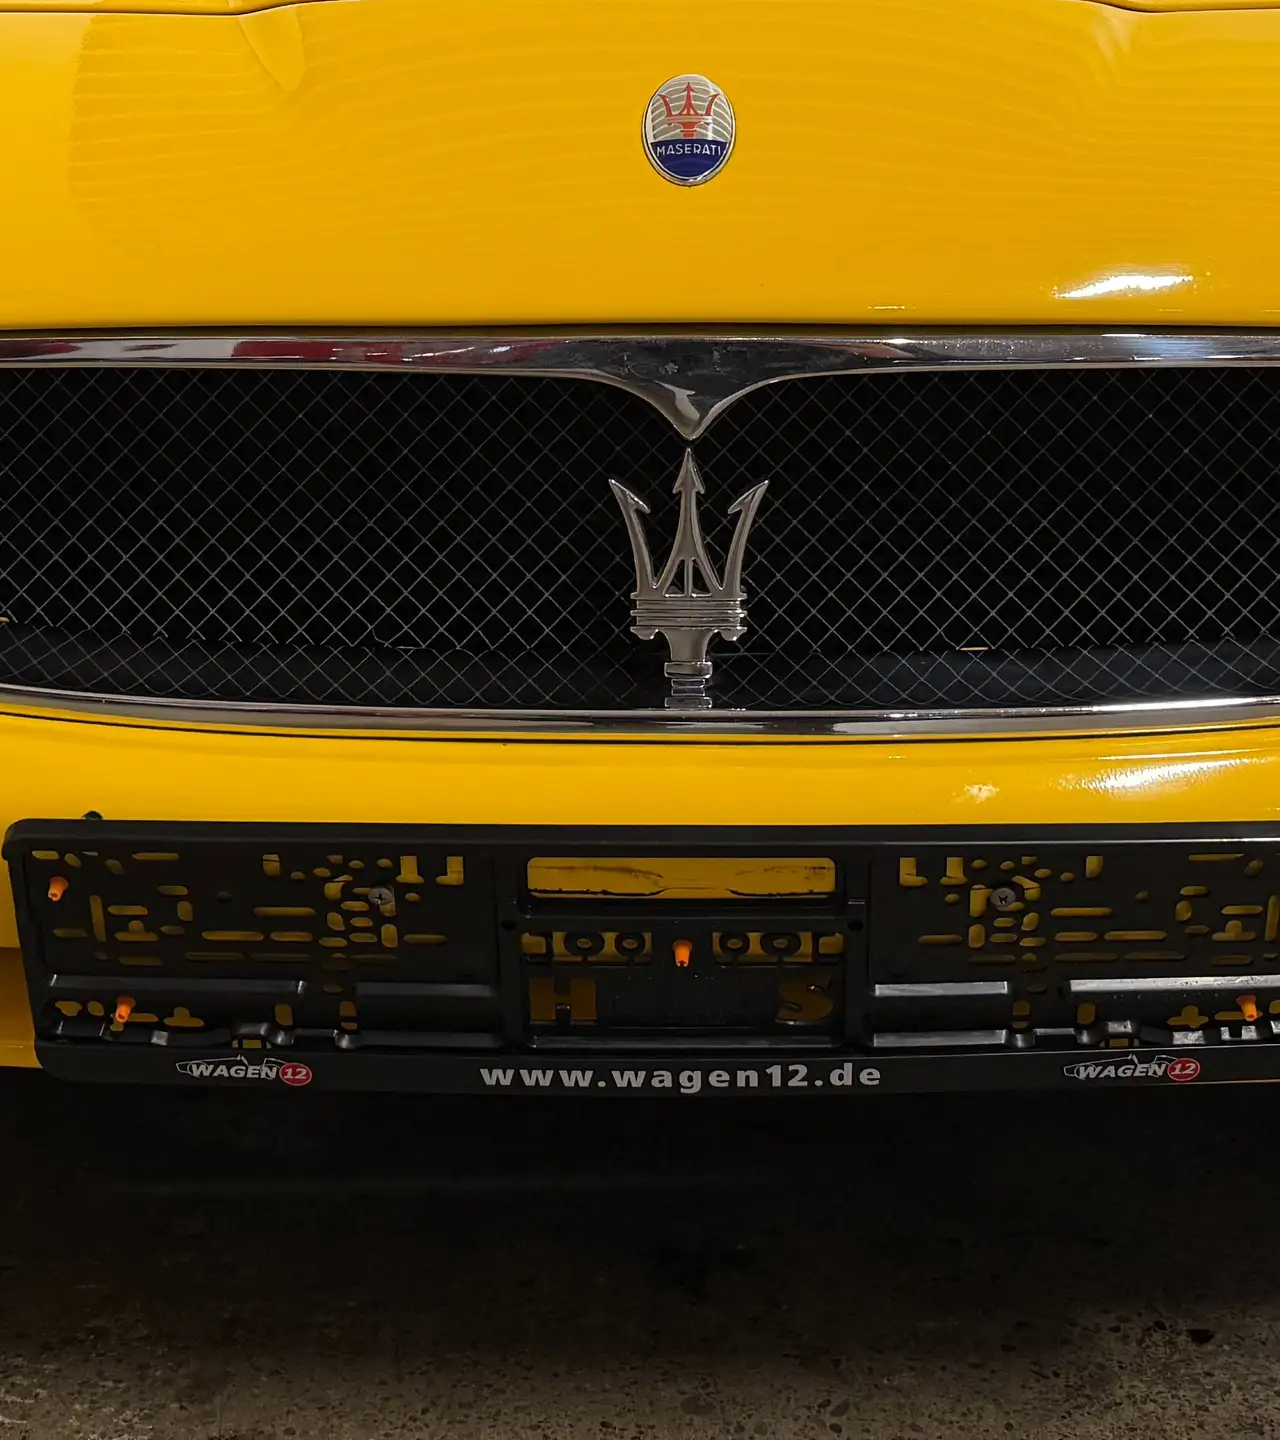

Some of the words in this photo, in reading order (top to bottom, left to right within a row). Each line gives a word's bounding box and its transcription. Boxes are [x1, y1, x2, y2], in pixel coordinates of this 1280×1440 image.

[656, 144, 721, 157] MASERATI
[191, 1064, 278, 1079] WAGEN
[283, 1068, 308, 1079] 12
[479, 1062, 882, 1093] www.wagen12.de
[1078, 1063, 1167, 1079] WAGEN
[1171, 1063, 1196, 1075] 12
